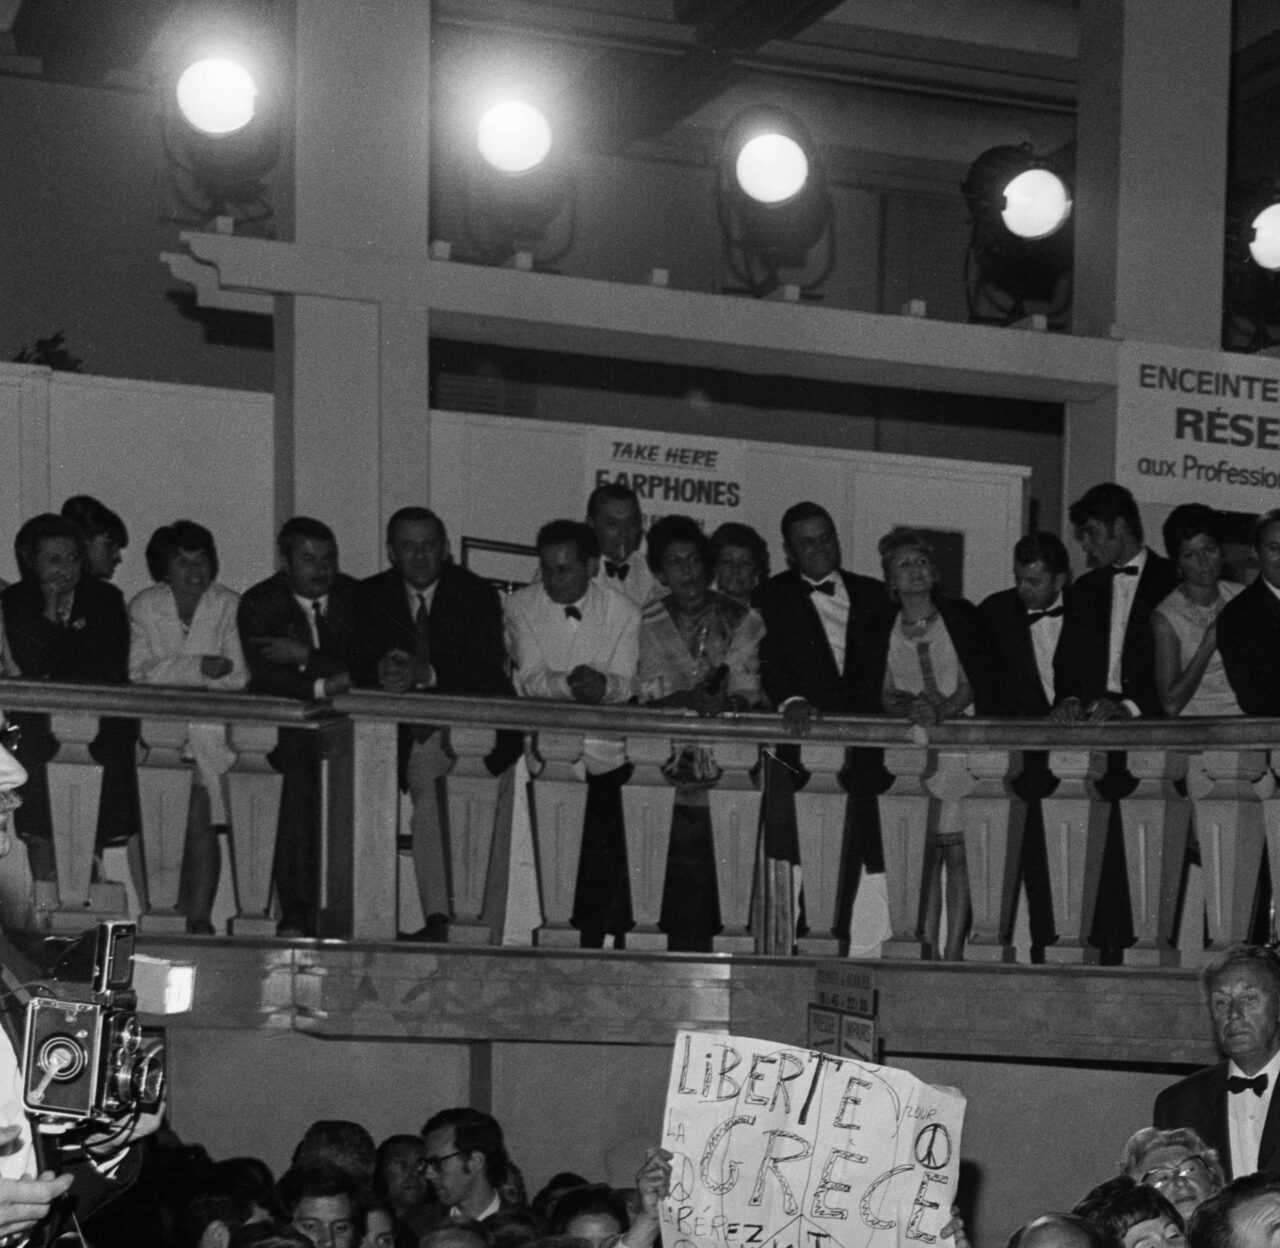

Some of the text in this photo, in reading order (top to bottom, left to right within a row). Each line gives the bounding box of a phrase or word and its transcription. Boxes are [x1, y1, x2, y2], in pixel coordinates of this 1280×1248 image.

[1139, 364, 1279, 402] ENCEINTE
[611, 441, 719, 468] TAKE HERE
[1138, 457, 1176, 478] aux
[666, 1107, 686, 1145] LA
